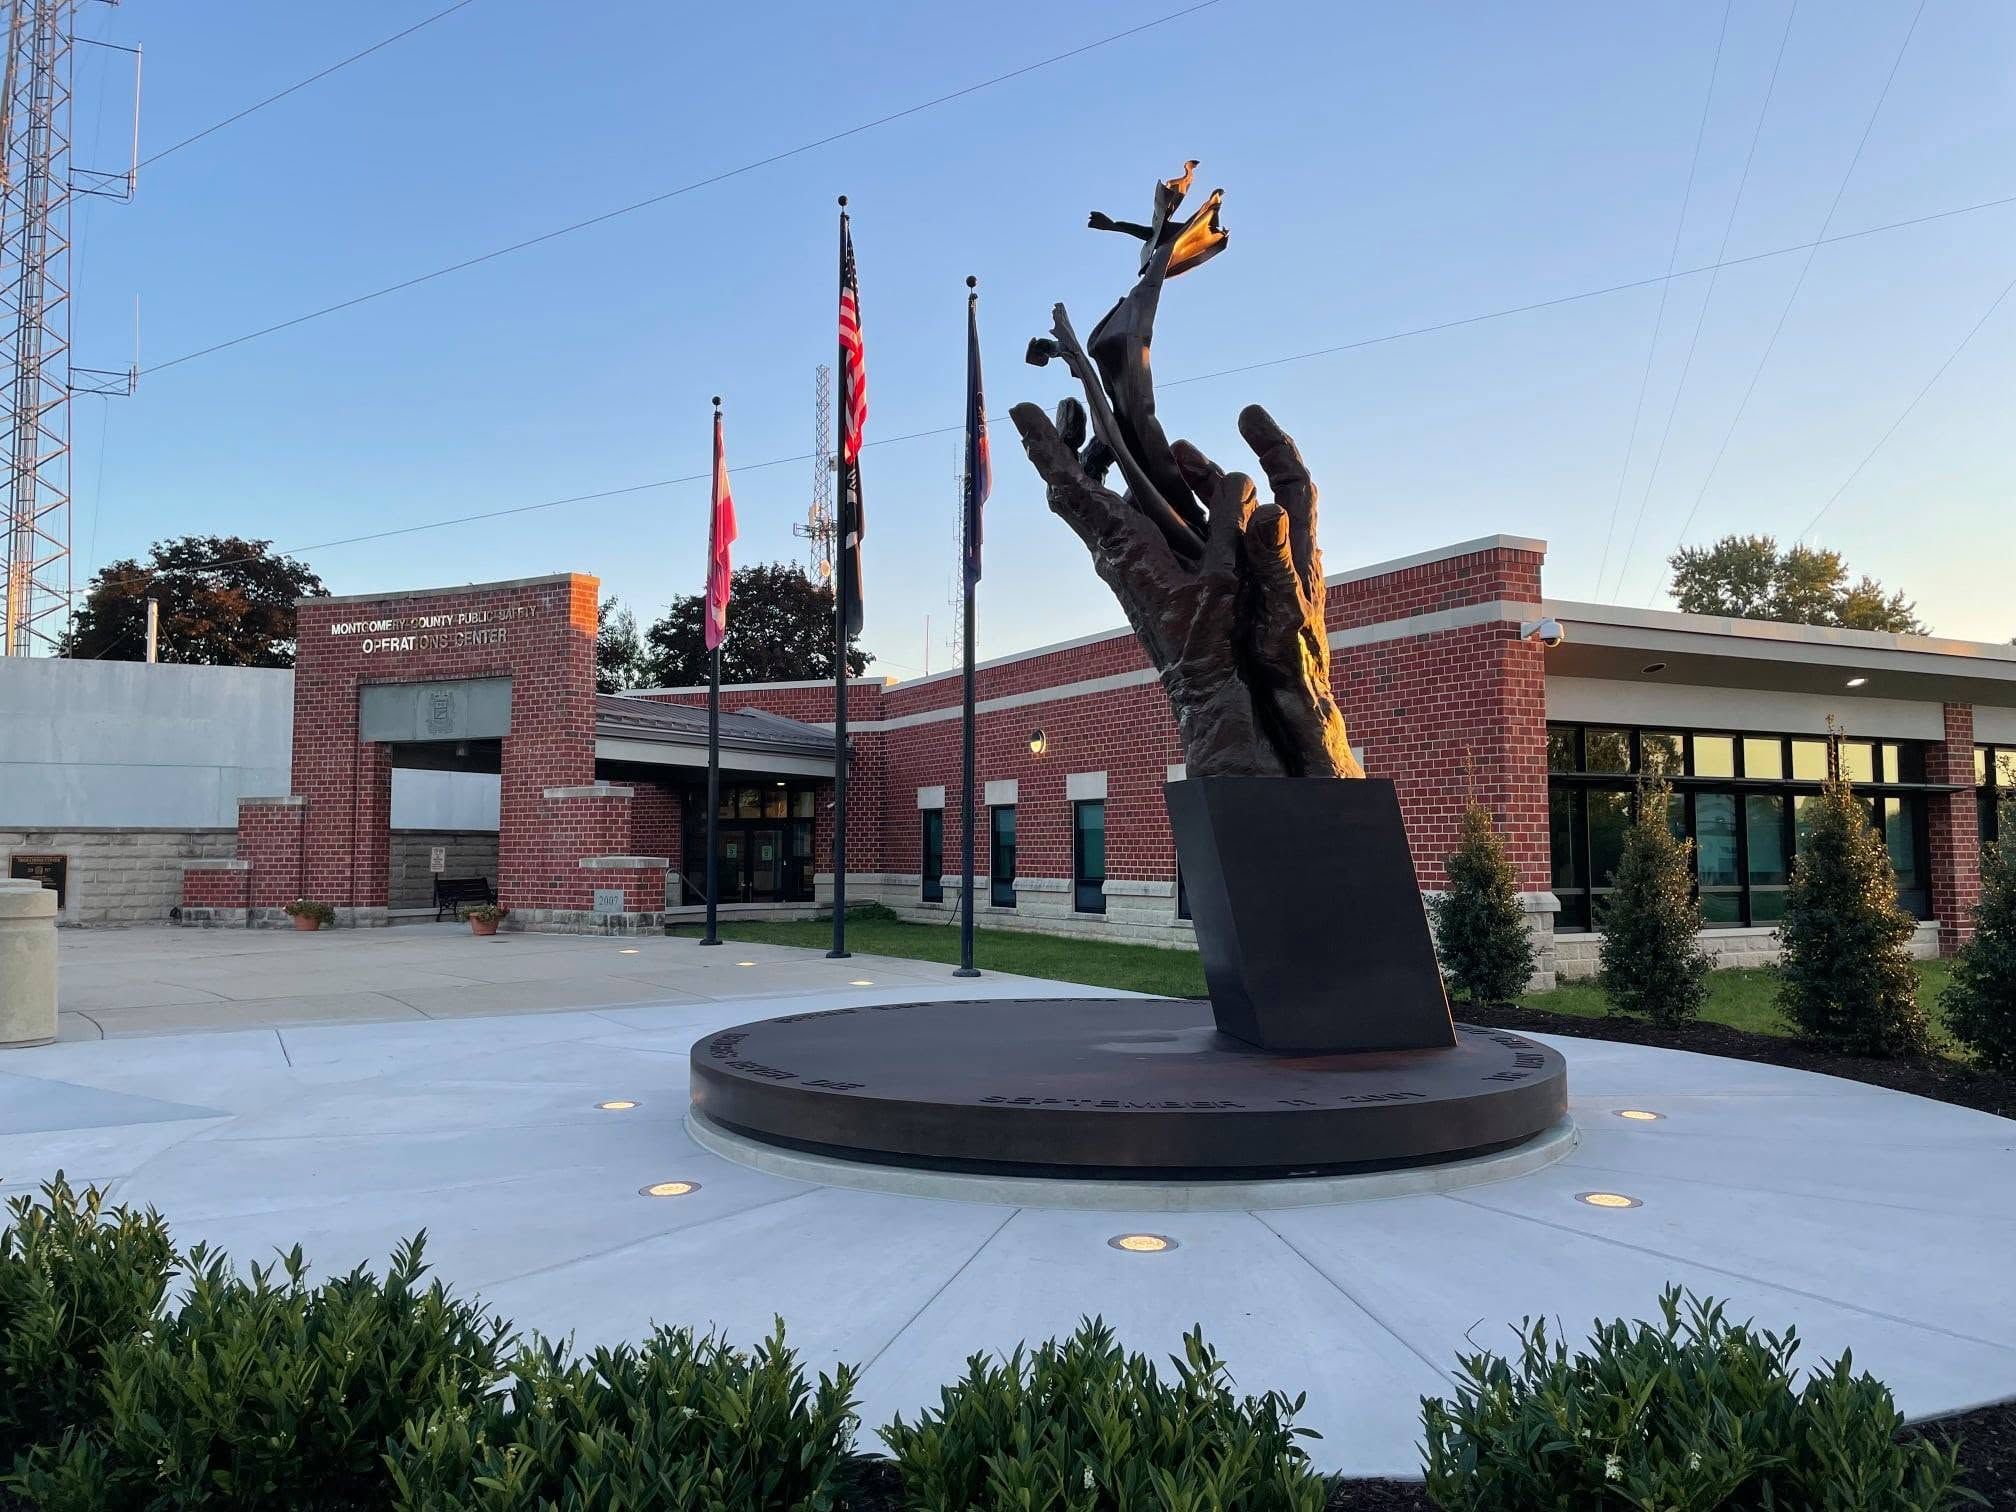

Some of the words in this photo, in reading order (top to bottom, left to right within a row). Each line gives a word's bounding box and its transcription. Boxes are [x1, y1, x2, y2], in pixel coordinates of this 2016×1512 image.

[331, 618, 406, 635] MONTGOMERY
[410, 615, 453, 629] COUNTY
[458, 611, 493, 625] PUBLIC
[362, 634, 448, 653] OPERATIONS
[455, 628, 507, 647] CENTER
[598, 895, 619, 906] 2007
[979, 1095, 1246, 1109] SEPTEMBER
